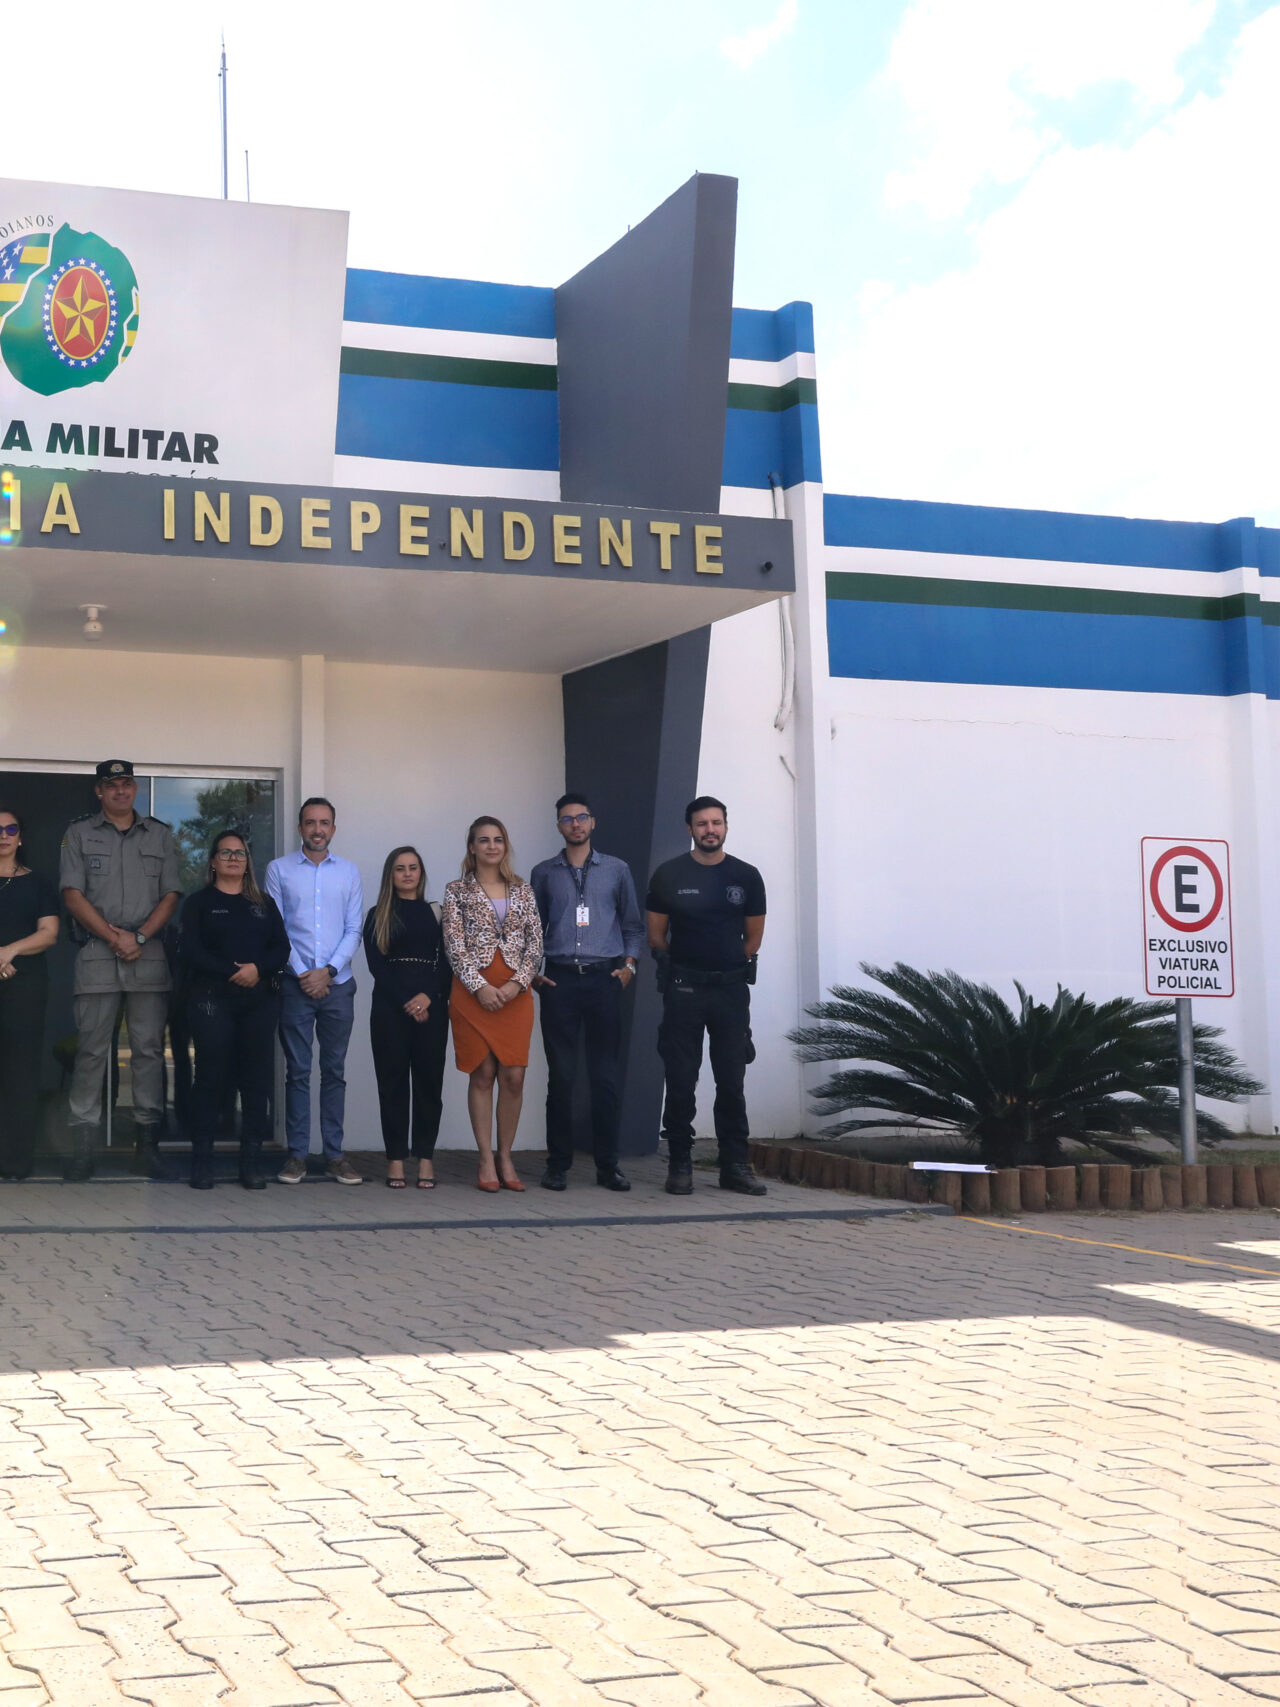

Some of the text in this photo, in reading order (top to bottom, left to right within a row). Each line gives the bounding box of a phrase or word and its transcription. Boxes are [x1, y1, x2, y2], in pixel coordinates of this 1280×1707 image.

[45, 422, 220, 465] MILITAR
[163, 488, 724, 574] INDEPENDENTE
[1174, 865, 1200, 913] E
[1149, 938, 1228, 954] EXCLUSIVO
[1159, 957, 1220, 972] VIATURA
[1157, 975, 1222, 990] POLICIAL
